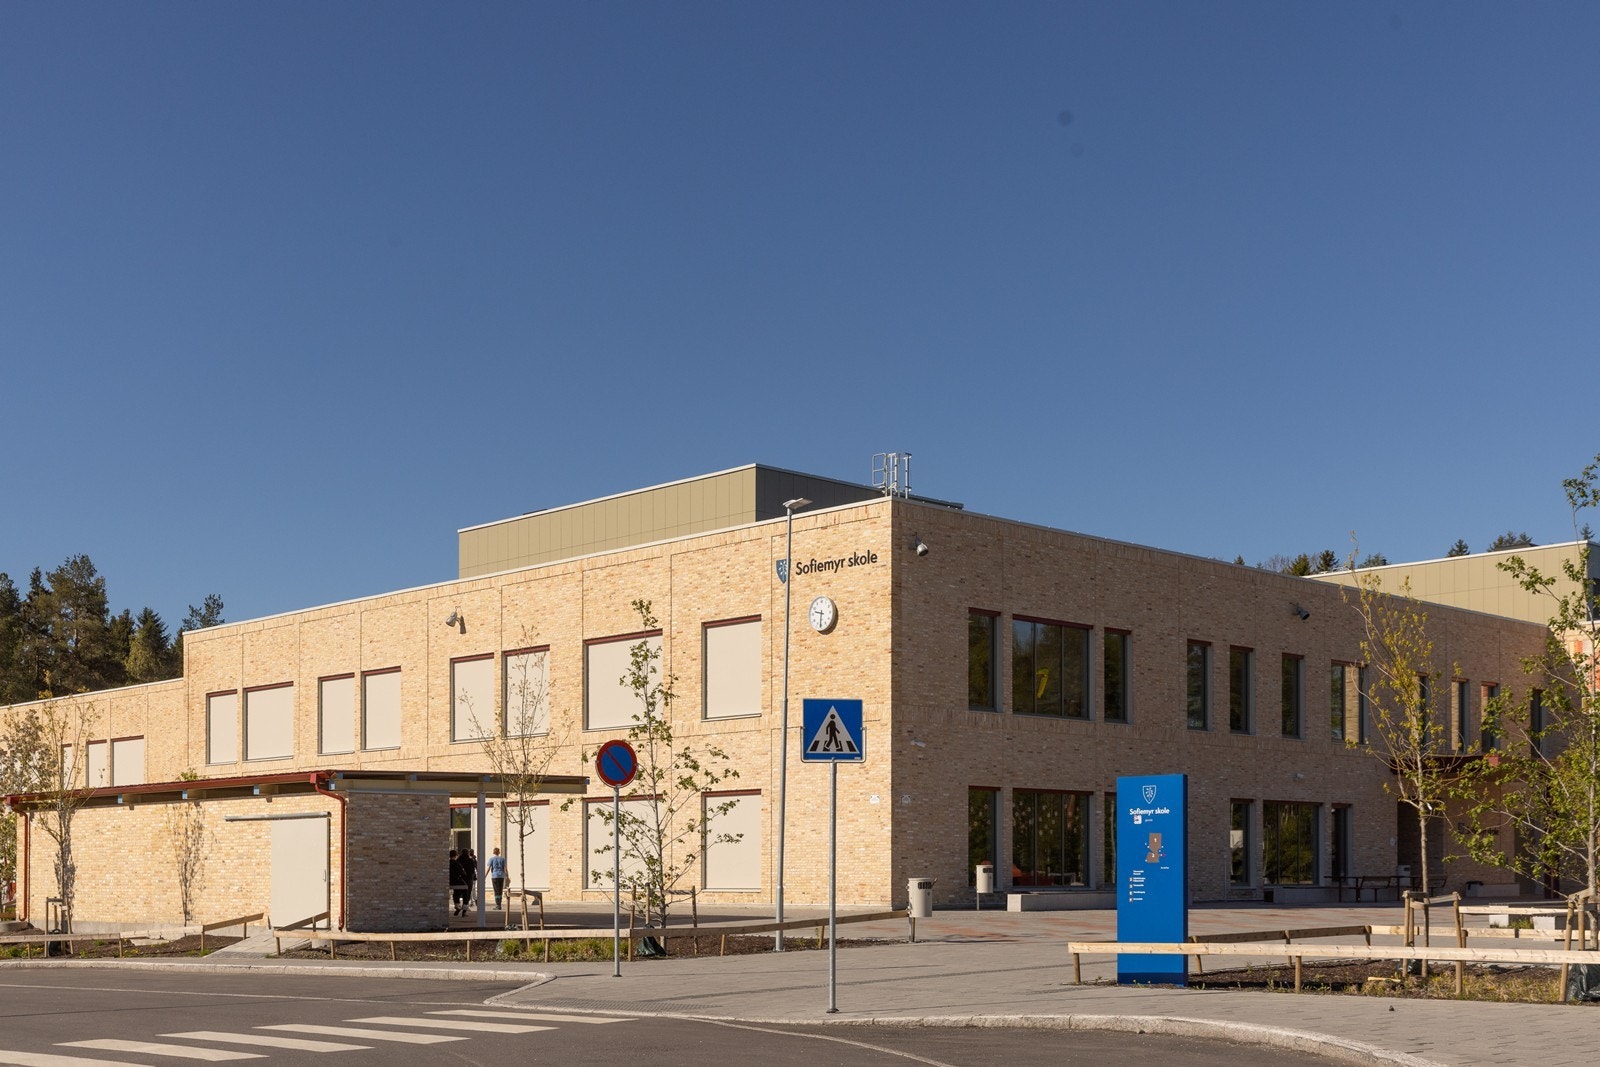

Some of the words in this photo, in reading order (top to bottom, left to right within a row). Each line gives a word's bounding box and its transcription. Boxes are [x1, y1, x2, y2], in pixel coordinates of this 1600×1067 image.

[795, 558, 846, 575] Sofiemyr
[848, 549, 878, 567] skole
[1129, 807, 1155, 816] Sofiemyr
[1155, 807, 1170, 815] skole
